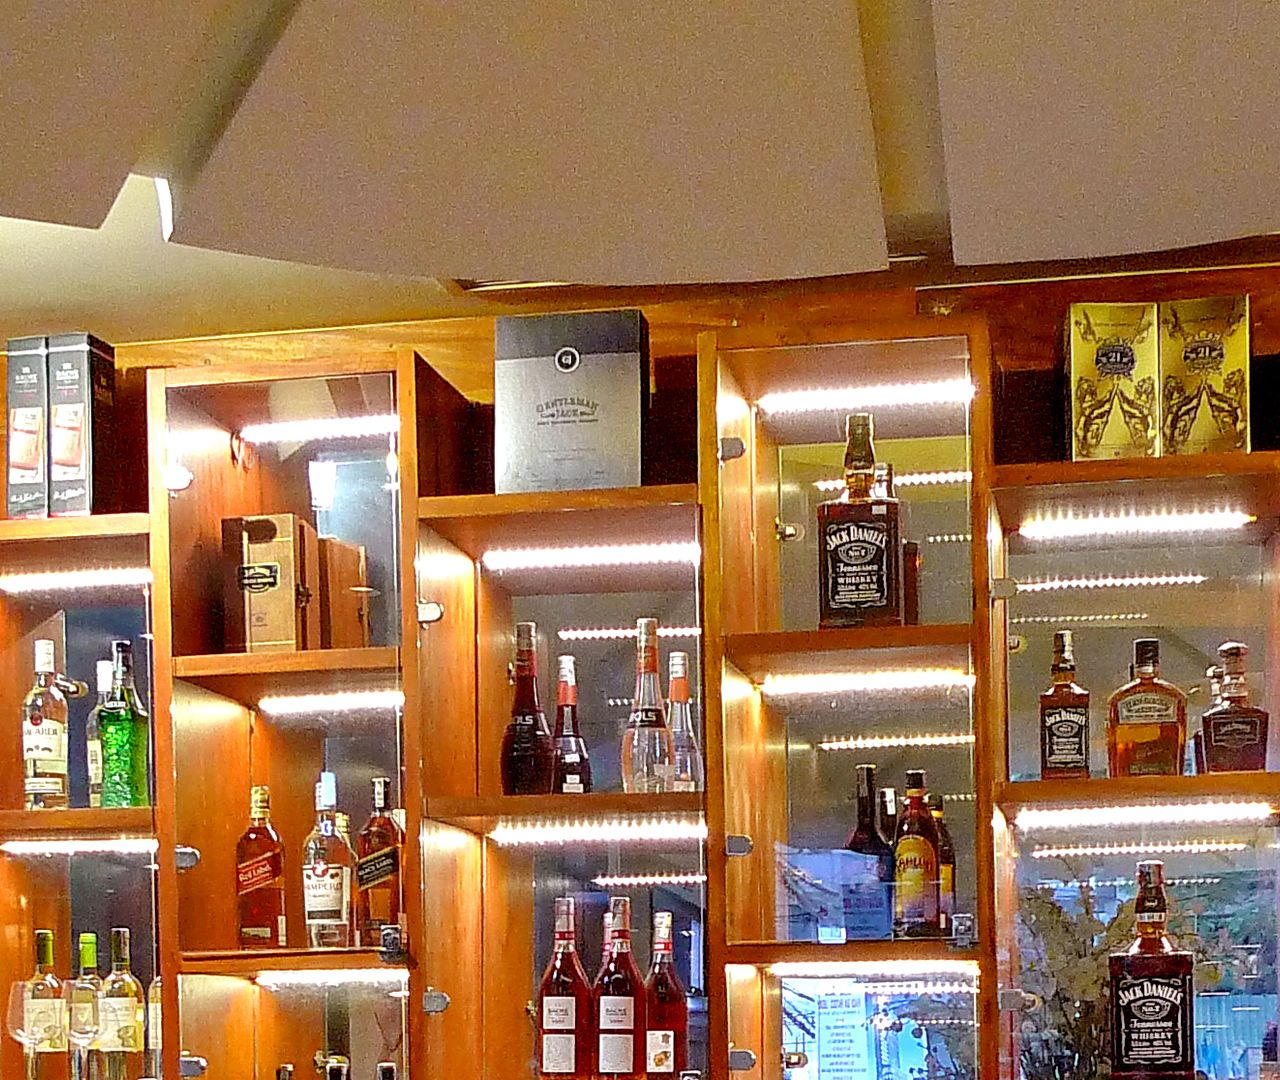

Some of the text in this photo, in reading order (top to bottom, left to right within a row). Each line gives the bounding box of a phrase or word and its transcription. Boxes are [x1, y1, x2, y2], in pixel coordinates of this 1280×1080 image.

[1108, 351, 1121, 362] 21
[1198, 346, 1210, 358] 21
[825, 530, 850, 551] JACK
[512, 714, 534, 725] OLS
[238, 870, 253, 883] Red
[1118, 981, 1184, 1006] JACK DANIEL'S
